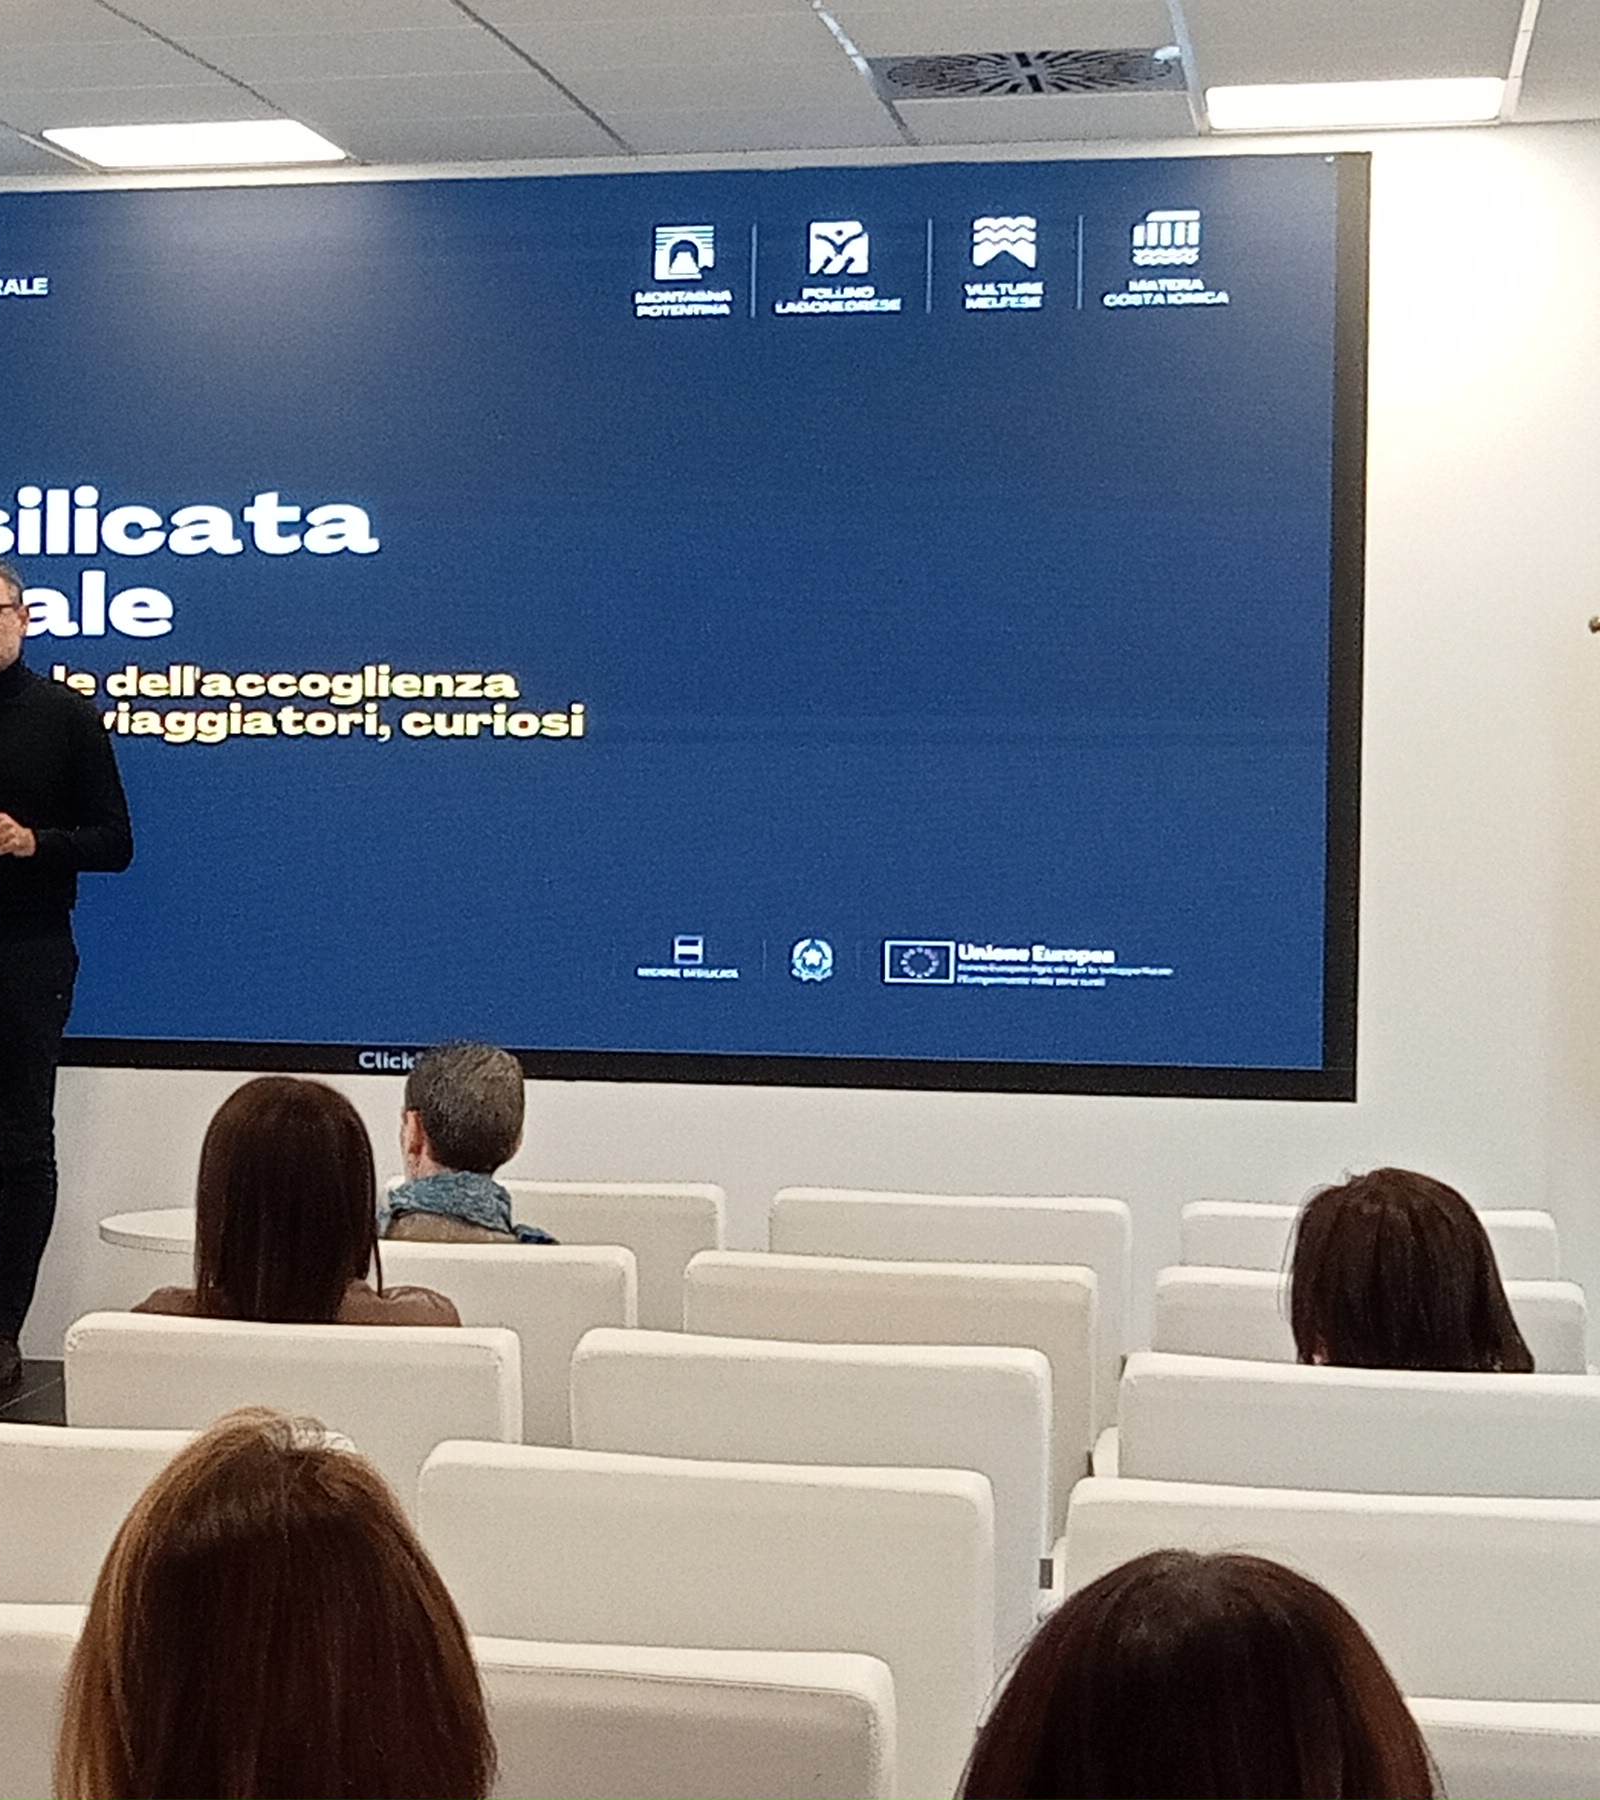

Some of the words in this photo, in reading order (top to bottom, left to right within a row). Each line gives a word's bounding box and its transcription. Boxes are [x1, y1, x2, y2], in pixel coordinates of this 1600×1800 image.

[106, 664, 521, 706] dell'accoglienza
[401, 702, 585, 738] curiosi
[1031, 945, 1116, 965] Europea
